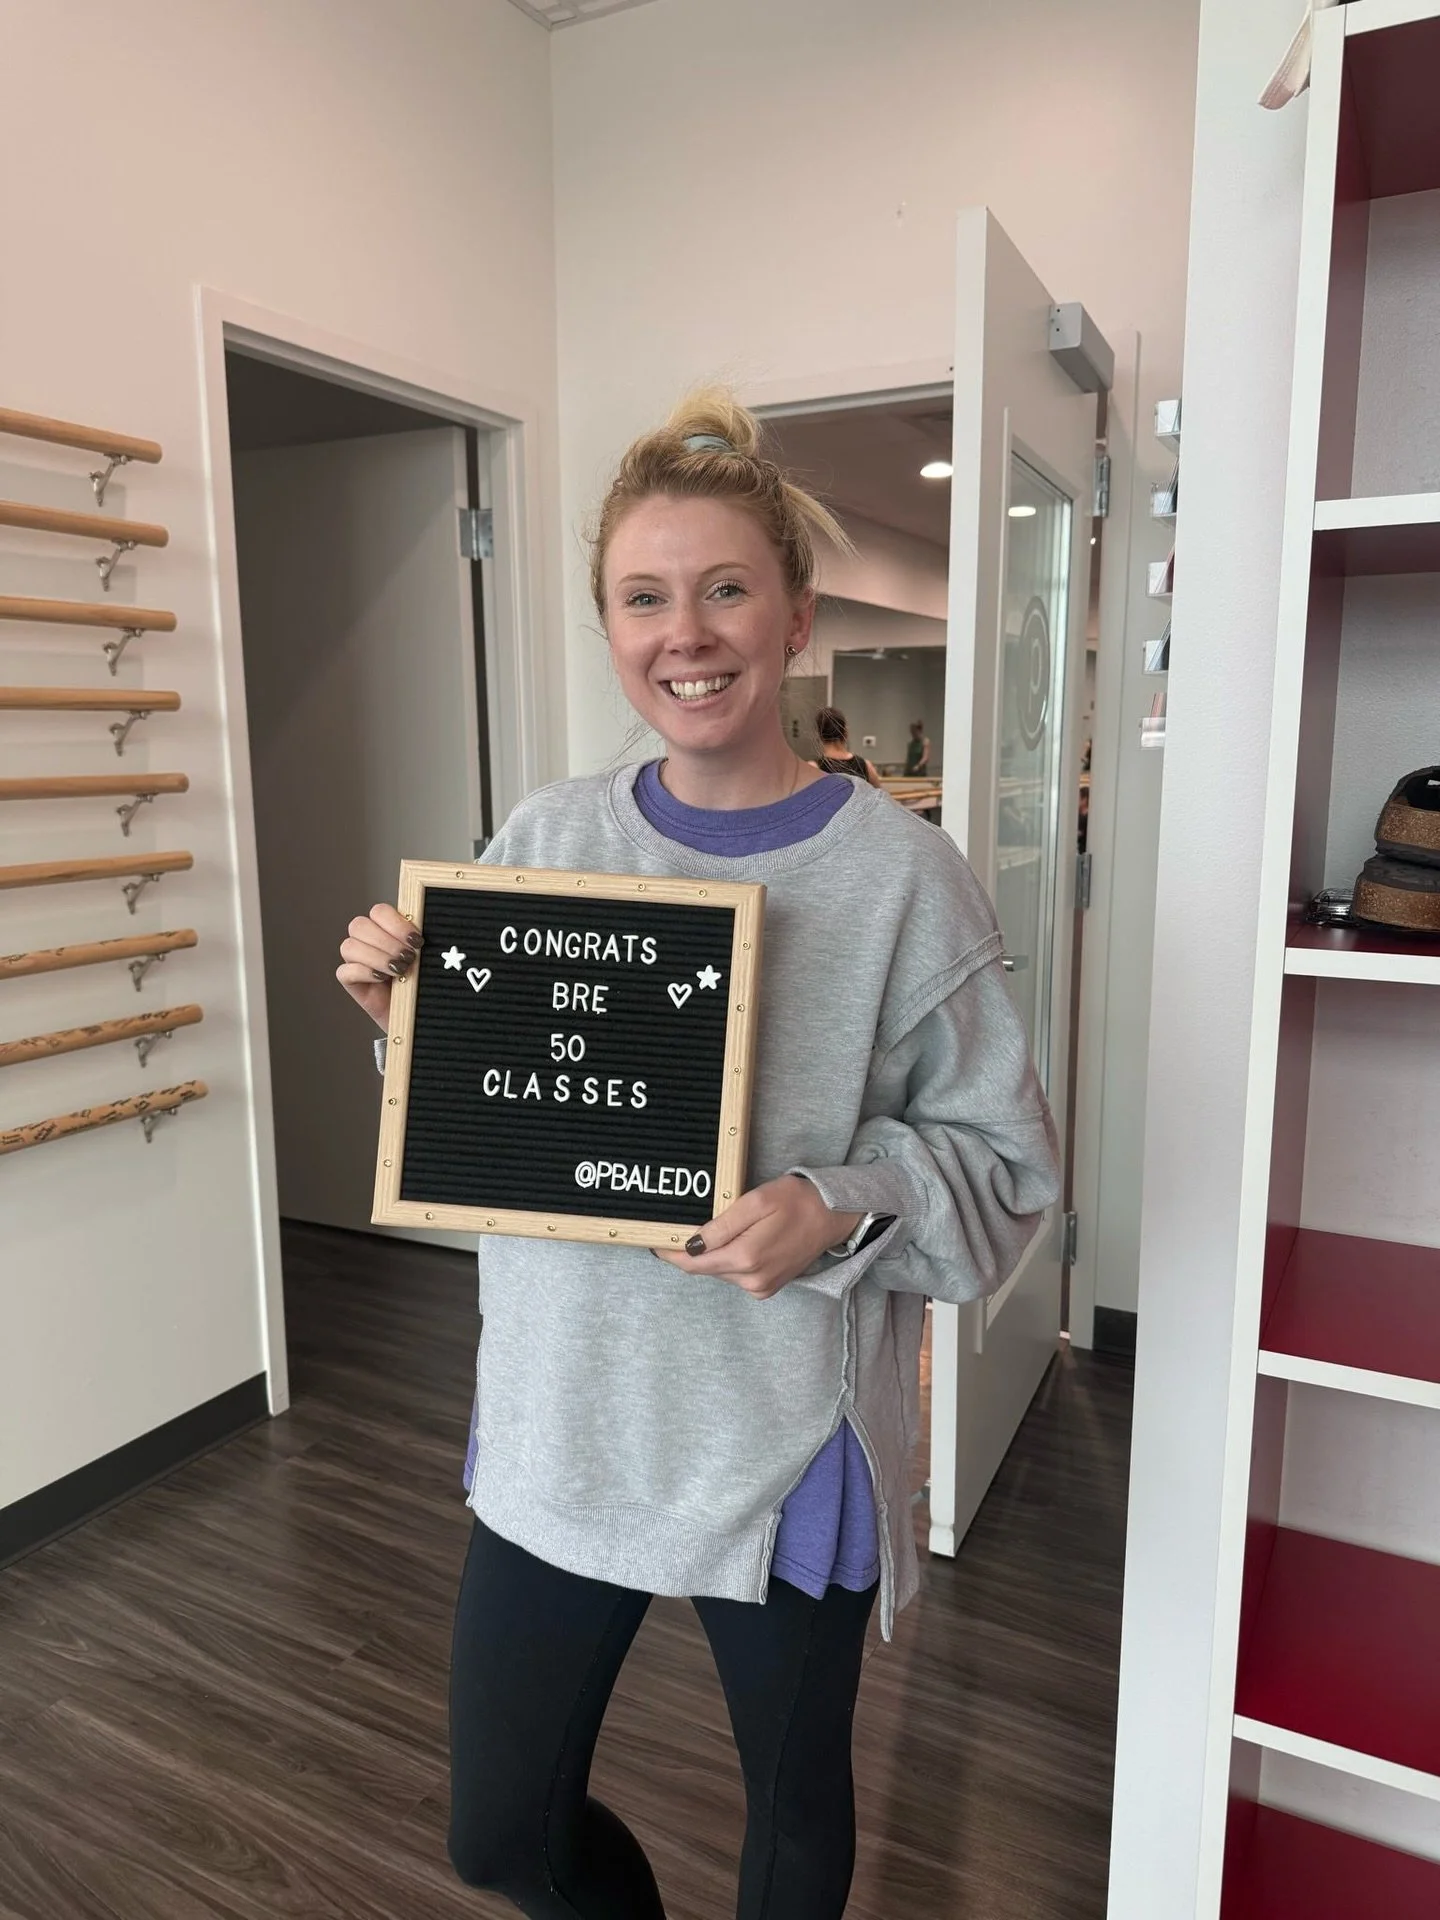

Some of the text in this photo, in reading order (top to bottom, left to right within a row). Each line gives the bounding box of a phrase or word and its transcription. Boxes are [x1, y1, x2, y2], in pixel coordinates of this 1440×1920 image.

[500, 926, 658, 965] CONGRATS
[551, 981, 610, 1015] BRE
[549, 1033, 586, 1062] 50
[482, 1068, 648, 1109] CLASSES
[574, 1160, 712, 1198] @PBALEDO
